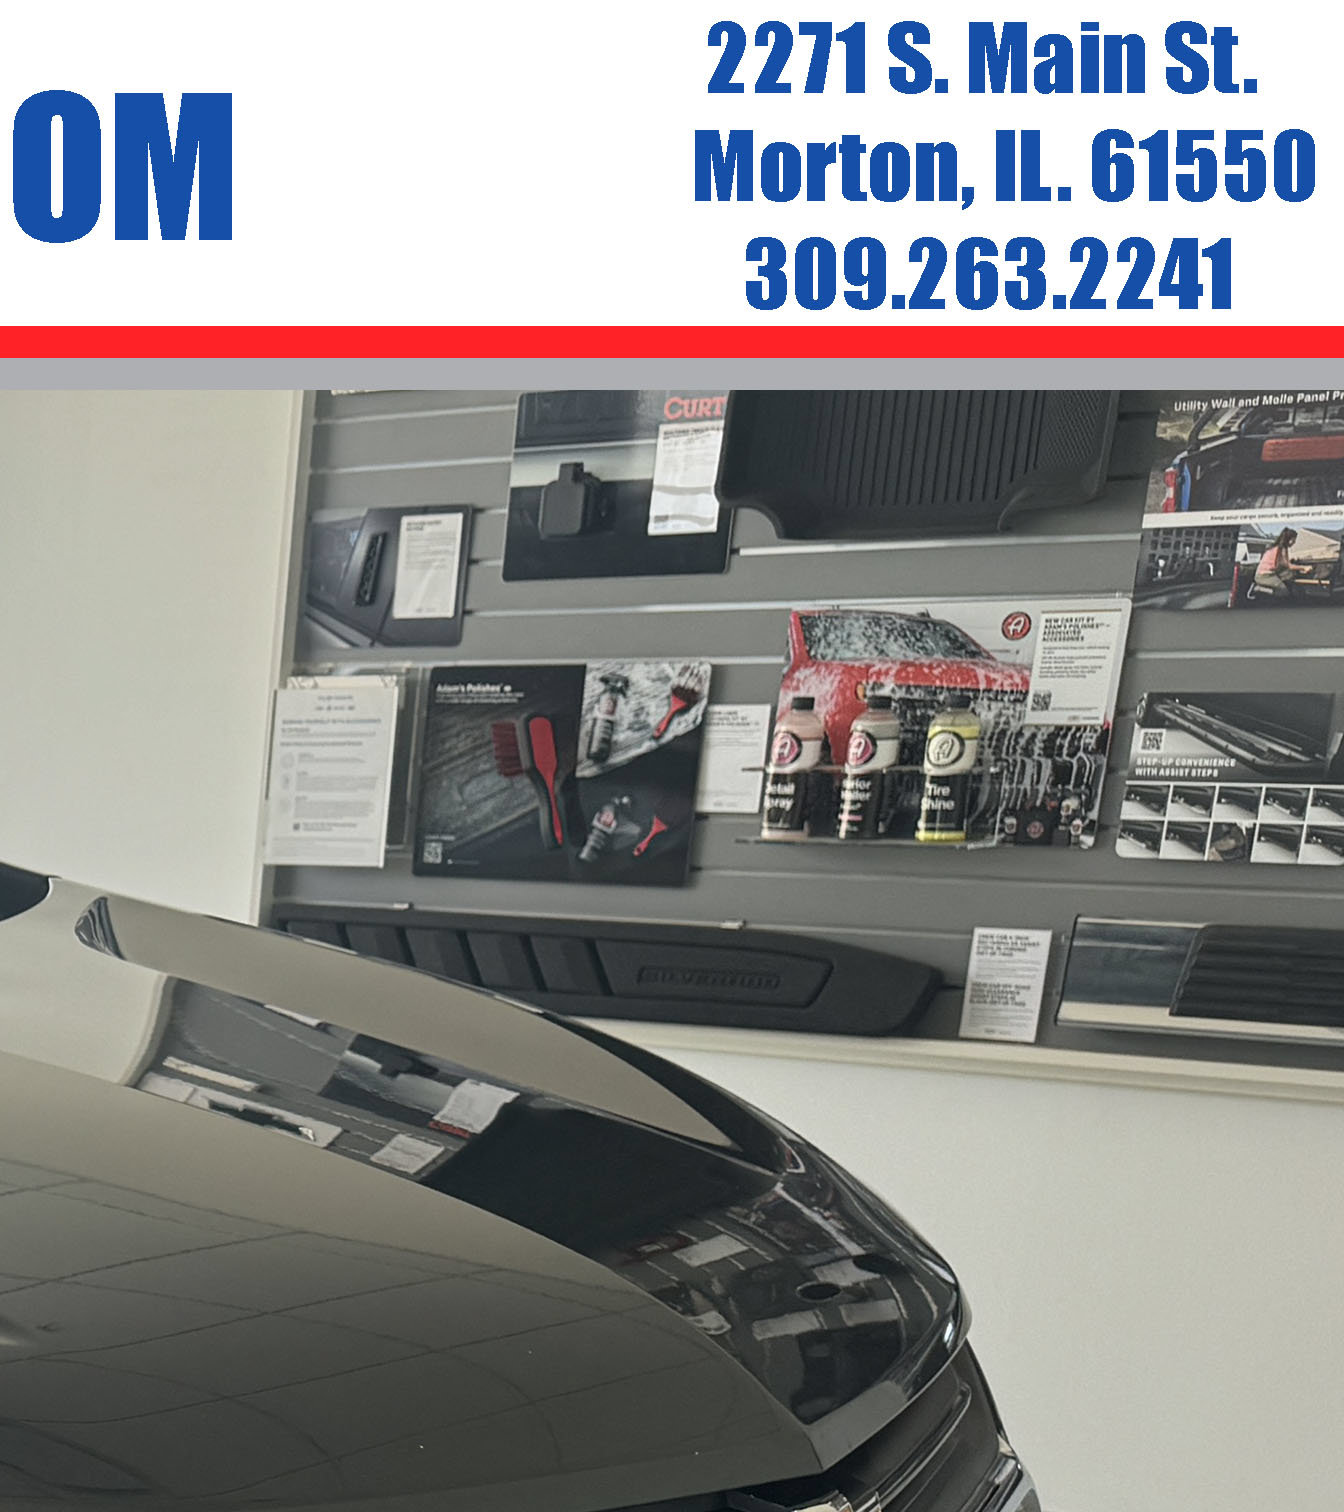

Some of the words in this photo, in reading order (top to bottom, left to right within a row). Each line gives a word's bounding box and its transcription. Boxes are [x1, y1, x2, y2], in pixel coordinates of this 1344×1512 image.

[664, 396, 727, 420] CURT
[1174, 401, 1208, 412] Utility
[1212, 398, 1235, 409] Wall
[1238, 396, 1259, 407] and
[1262, 394, 1294, 405] Molle
[1297, 391, 1329, 403] Panel
[1135, 768, 1158, 777] WITH
[926, 784, 951, 797] Tire
